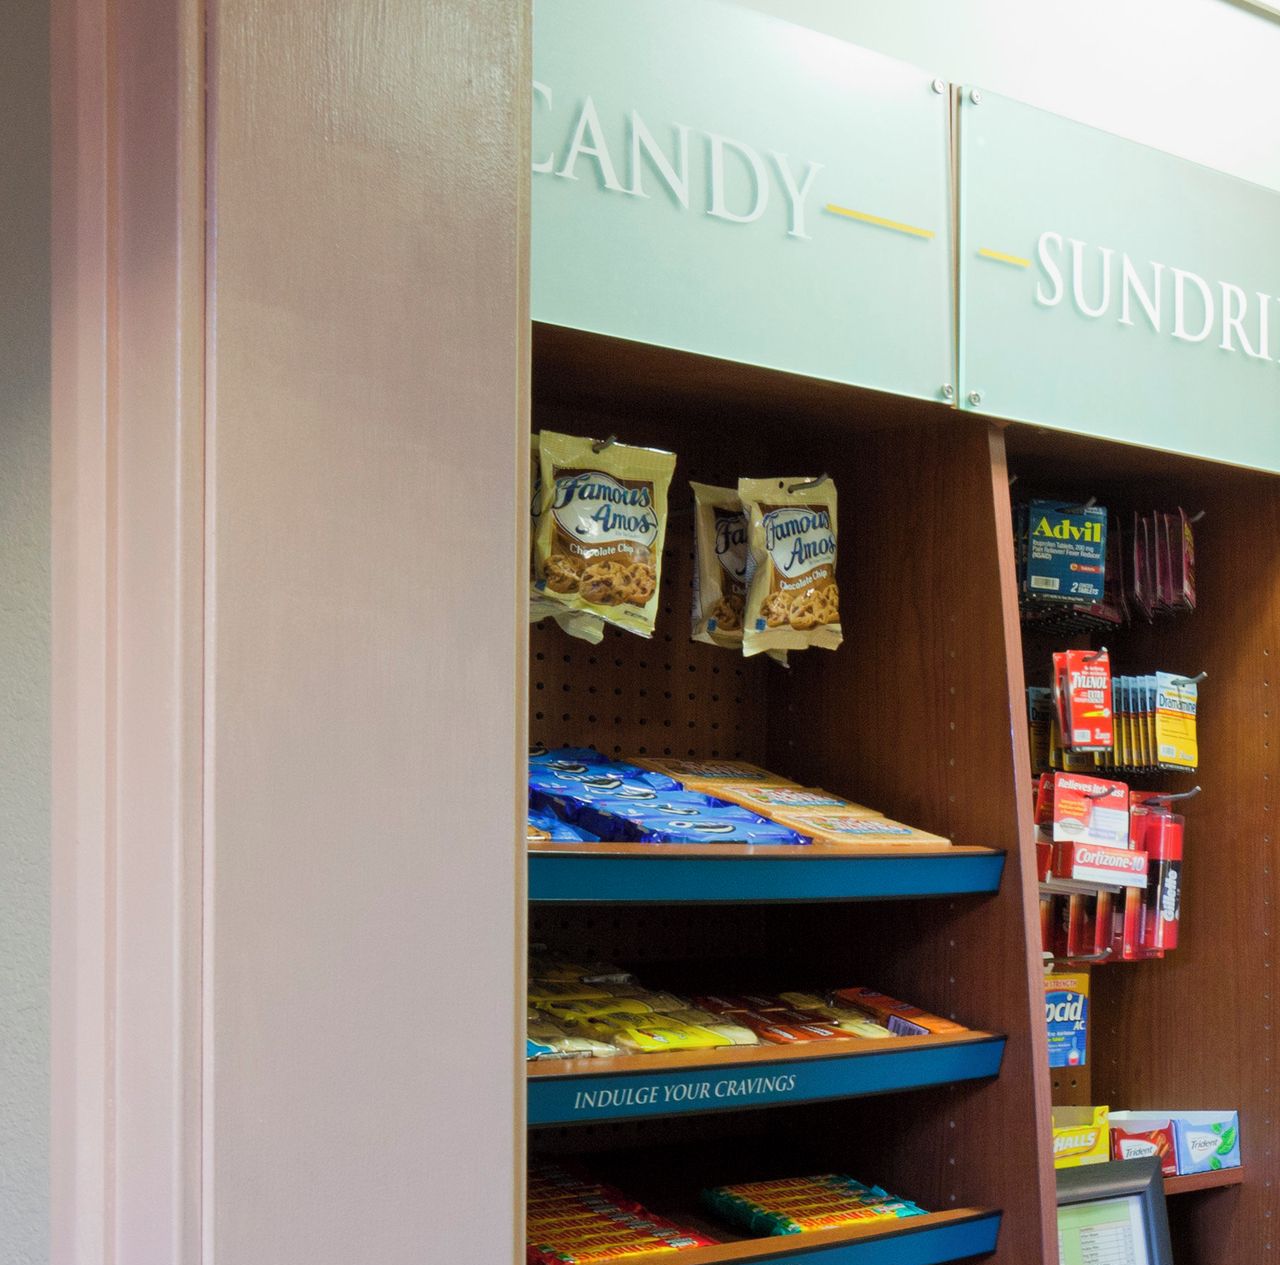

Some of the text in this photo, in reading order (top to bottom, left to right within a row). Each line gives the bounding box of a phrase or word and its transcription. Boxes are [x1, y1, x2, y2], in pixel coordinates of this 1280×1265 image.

[552, 474, 651, 509] Famous
[576, 503, 659, 535] Amos
[763, 510, 831, 551] Famous
[1032, 516, 1103, 543] Advil
[783, 536, 837, 571] Amos
[1071, 671, 1108, 690] TYLENOL
[1159, 694, 1197, 714] Dramamine
[1057, 777, 1093, 794] Relieves
[1109, 787, 1126, 798] ast
[1075, 848, 1145, 871] Cortizone-10
[574, 1074, 797, 1110] INDULGE YOUR CRAVINGS
[1053, 1132, 1097, 1153] HALLS
[1125, 1144, 1154, 1158] Trident
[1190, 1137, 1219, 1150] Trident
